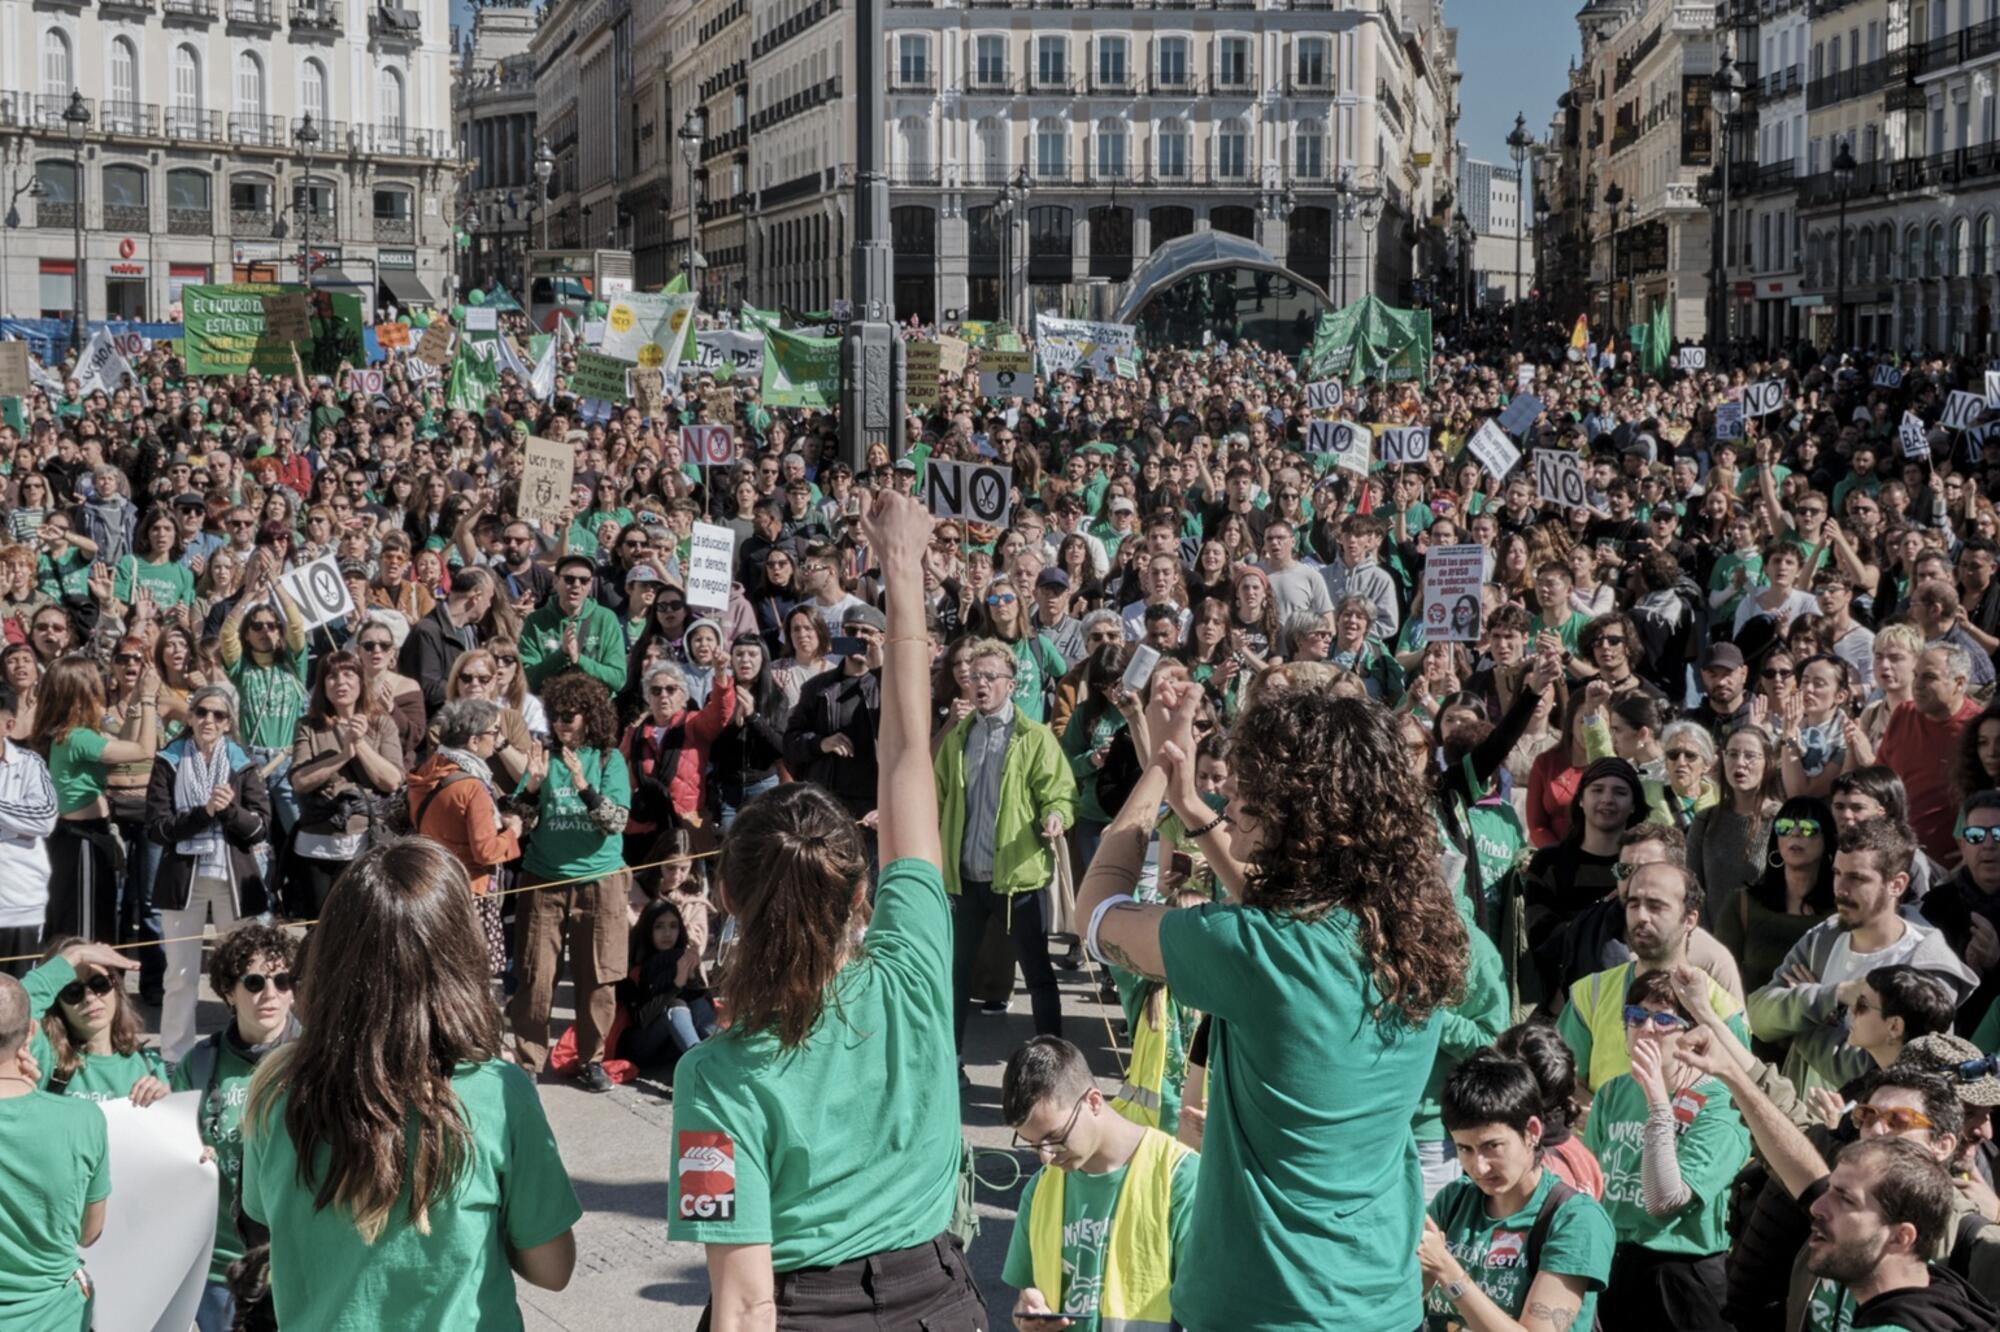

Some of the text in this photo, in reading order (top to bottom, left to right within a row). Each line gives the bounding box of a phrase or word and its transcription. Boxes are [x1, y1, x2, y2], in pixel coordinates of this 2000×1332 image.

[193, 299, 206, 313] EL
[209, 298, 250, 313] FUTURO
[235, 318, 250, 332] EN
[114, 333, 143, 356] NO
[1682, 349, 1704, 366] NO
[350, 371, 382, 393] NO
[1878, 366, 1901, 386] NO
[1308, 382, 1341, 406] NO
[1743, 381, 1783, 415] NO
[1941, 392, 1984, 426] NO
[683, 427, 732, 463] NO
[1309, 423, 1353, 451] NO
[1384, 429, 1426, 460] NO
[928, 462, 1006, 522] NO
[1540, 458, 1584, 506] NO
[680, 1193, 734, 1218] CGT
[1487, 1254, 1517, 1267] CGT
